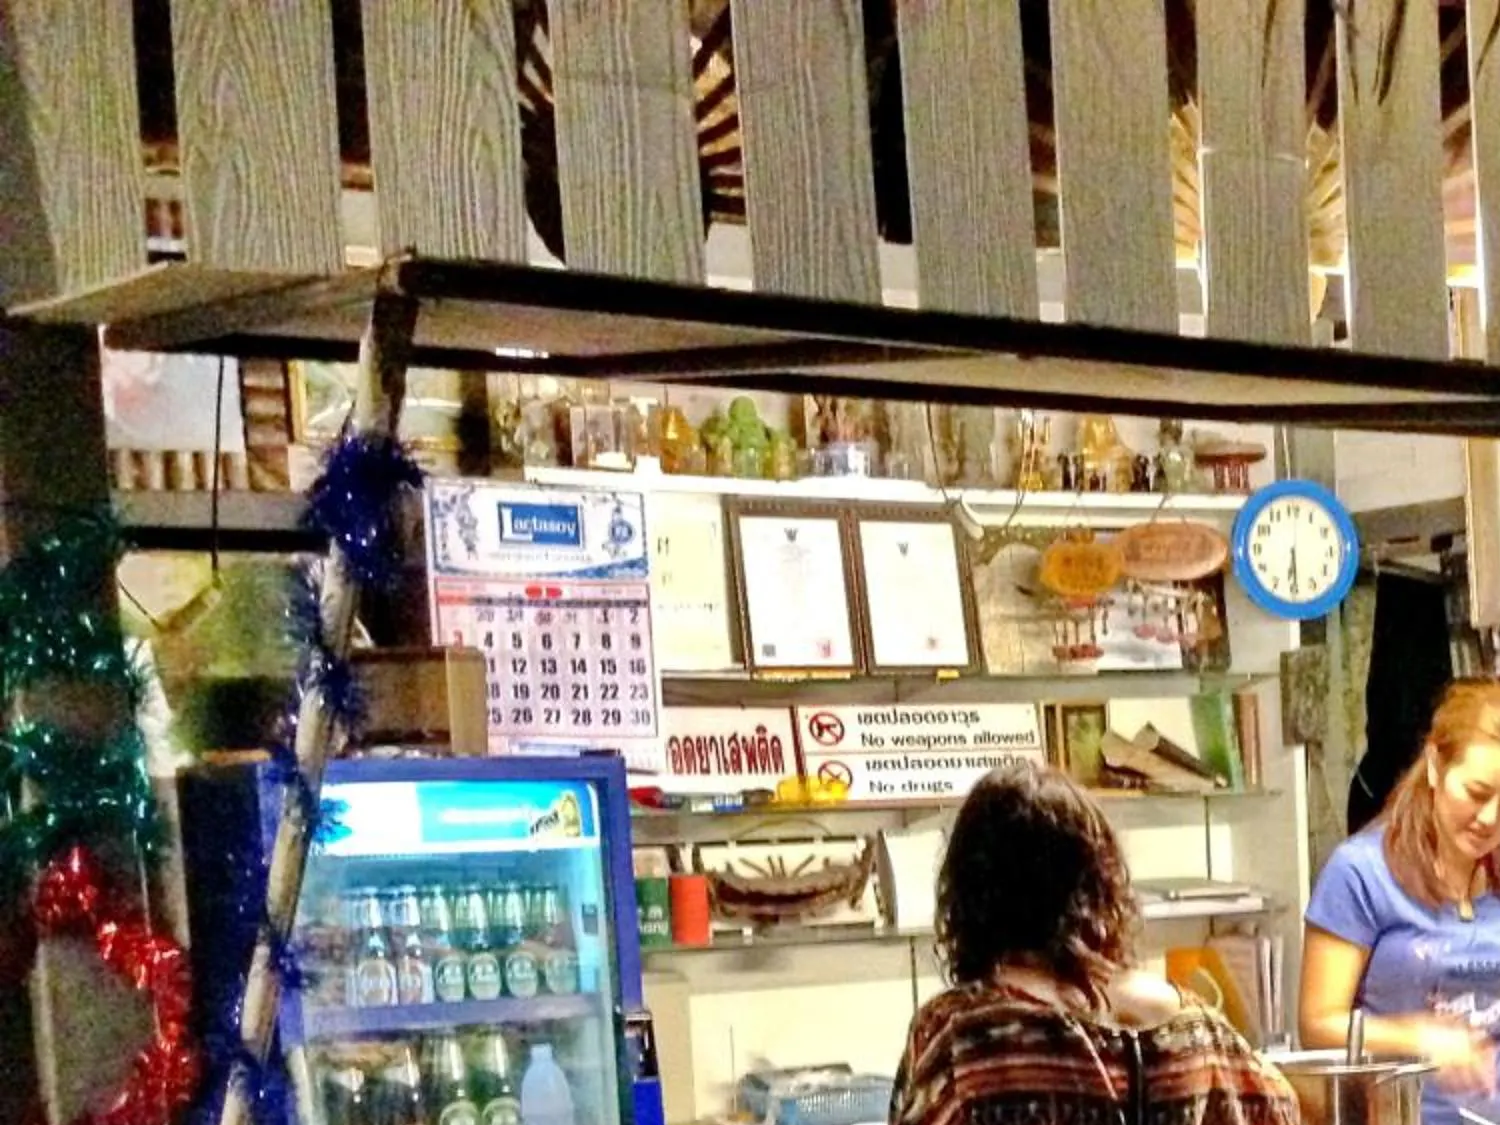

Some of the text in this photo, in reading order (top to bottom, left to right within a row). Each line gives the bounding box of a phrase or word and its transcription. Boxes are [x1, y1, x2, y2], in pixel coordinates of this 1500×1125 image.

[501, 507, 577, 542] Lactasoy
[629, 606, 638, 623] 2
[484, 631, 494, 648] 4
[511, 631, 523, 649] 5
[541, 632, 553, 649] 6
[572, 632, 581, 649] 7
[601, 632, 612, 649] 8
[630, 633, 642, 649] 9
[511, 658, 527, 674] 12
[541, 658, 557, 675] 13
[571, 658, 587, 675] 14
[600, 658, 617, 674] 15
[629, 658, 647, 675] 16
[512, 682, 530, 700] 19
[541, 683, 560, 700] 20
[571, 683, 589, 700] 21
[600, 683, 619, 700] 22
[630, 683, 649, 700] 23
[511, 707, 533, 724] 26
[543, 708, 561, 724] 27
[571, 708, 592, 725] 28
[601, 708, 621, 725] 29
[629, 708, 651, 725] 30
[860, 729, 1036, 749] No weapons allowed
[666, 724, 785, 775] อดยาเสพติด
[869, 778, 954, 794] No drugs
